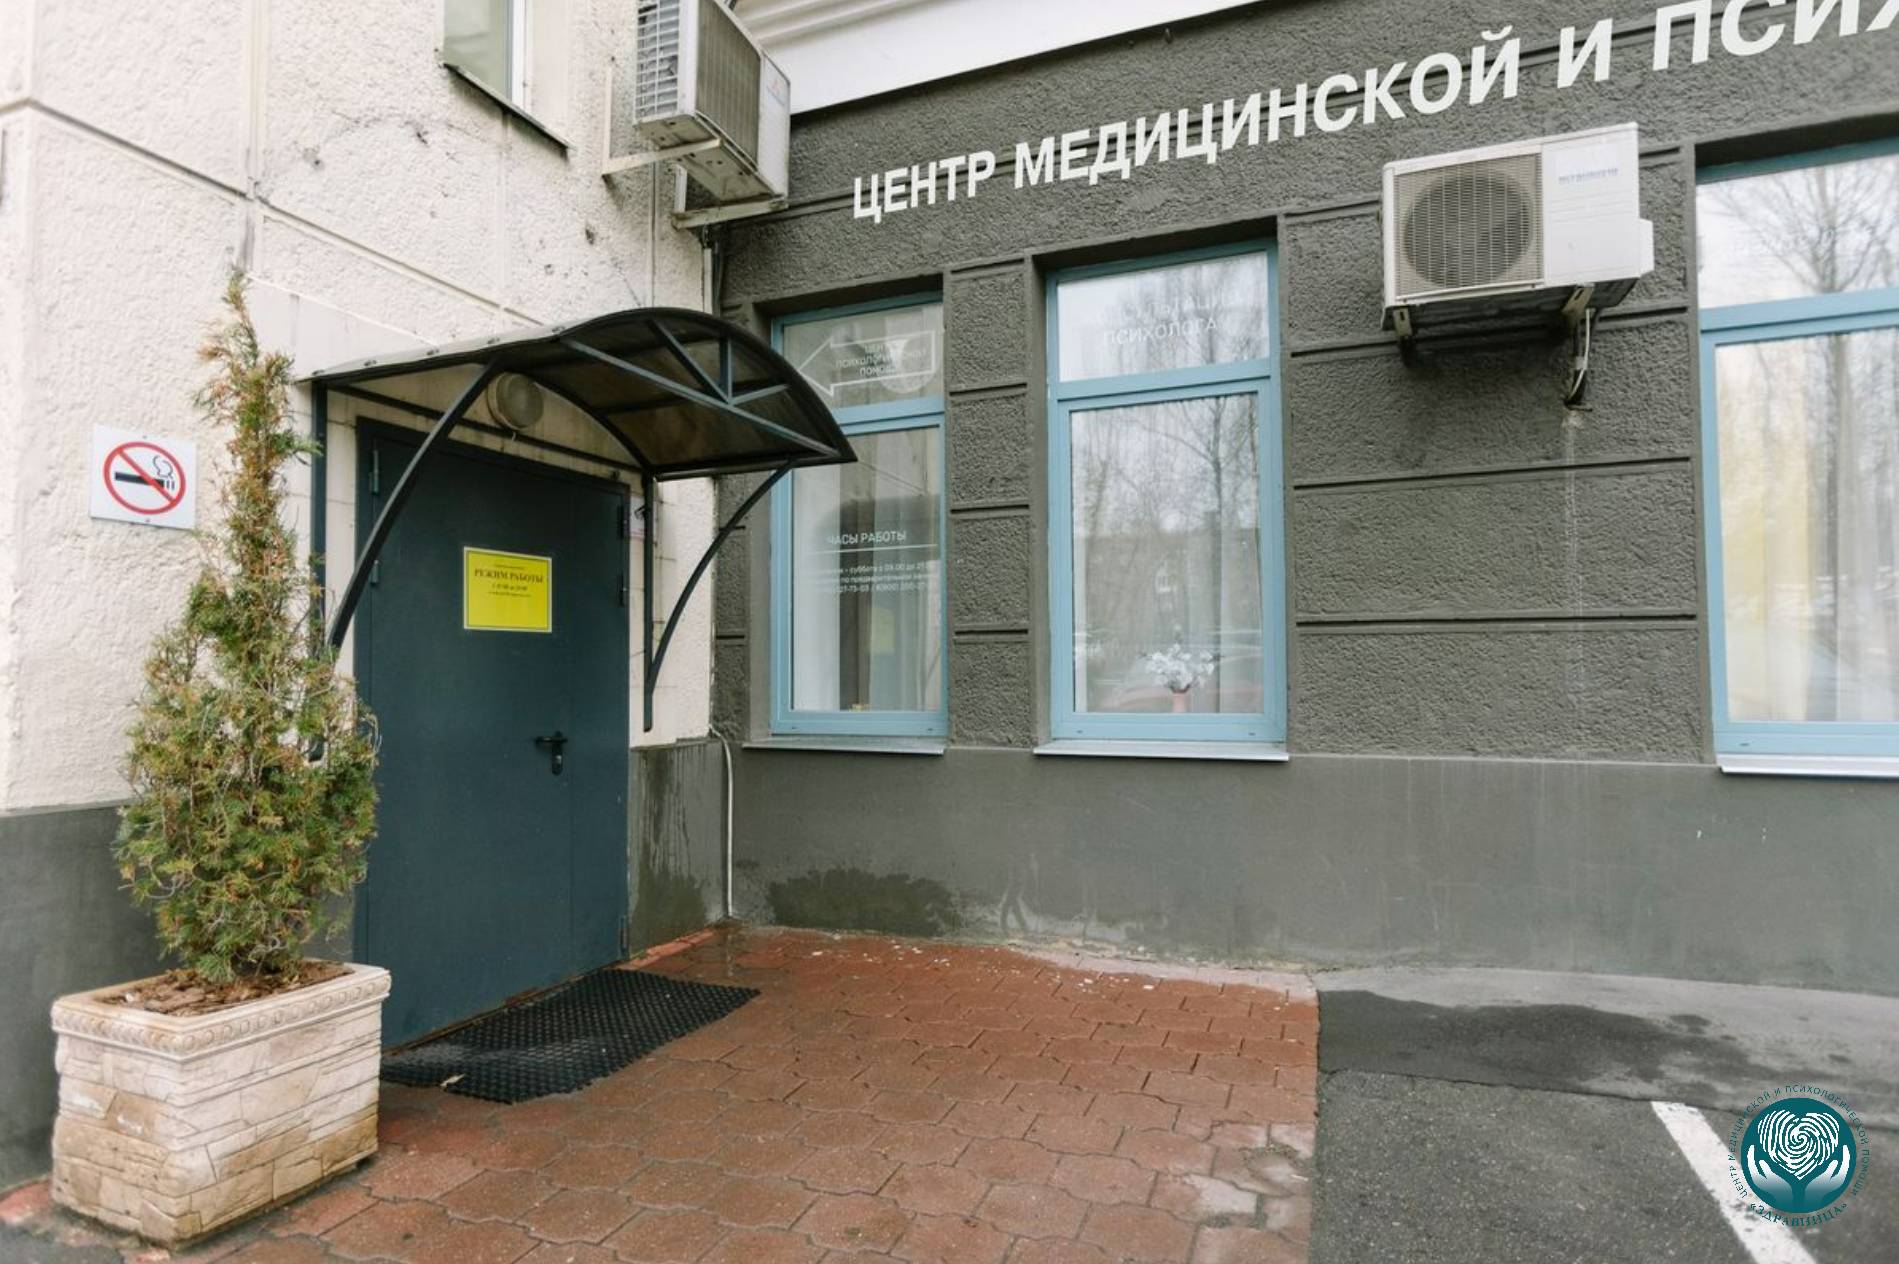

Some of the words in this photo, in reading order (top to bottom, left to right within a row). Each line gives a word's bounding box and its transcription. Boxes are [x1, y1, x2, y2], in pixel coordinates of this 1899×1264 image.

[852, 147, 996, 222] ЦЕНТР
[1014, 26, 1519, 185] МЕДИЦИНСКОЙ
[1557, 18, 1613, 88] И
[1652, 0, 1899, 71] ПСИ
[1103, 317, 1217, 346] ПСИХОЛОГА
[826, 533, 858, 545] ЧАСЫ
[860, 530, 907, 543] РАБОТЫ
